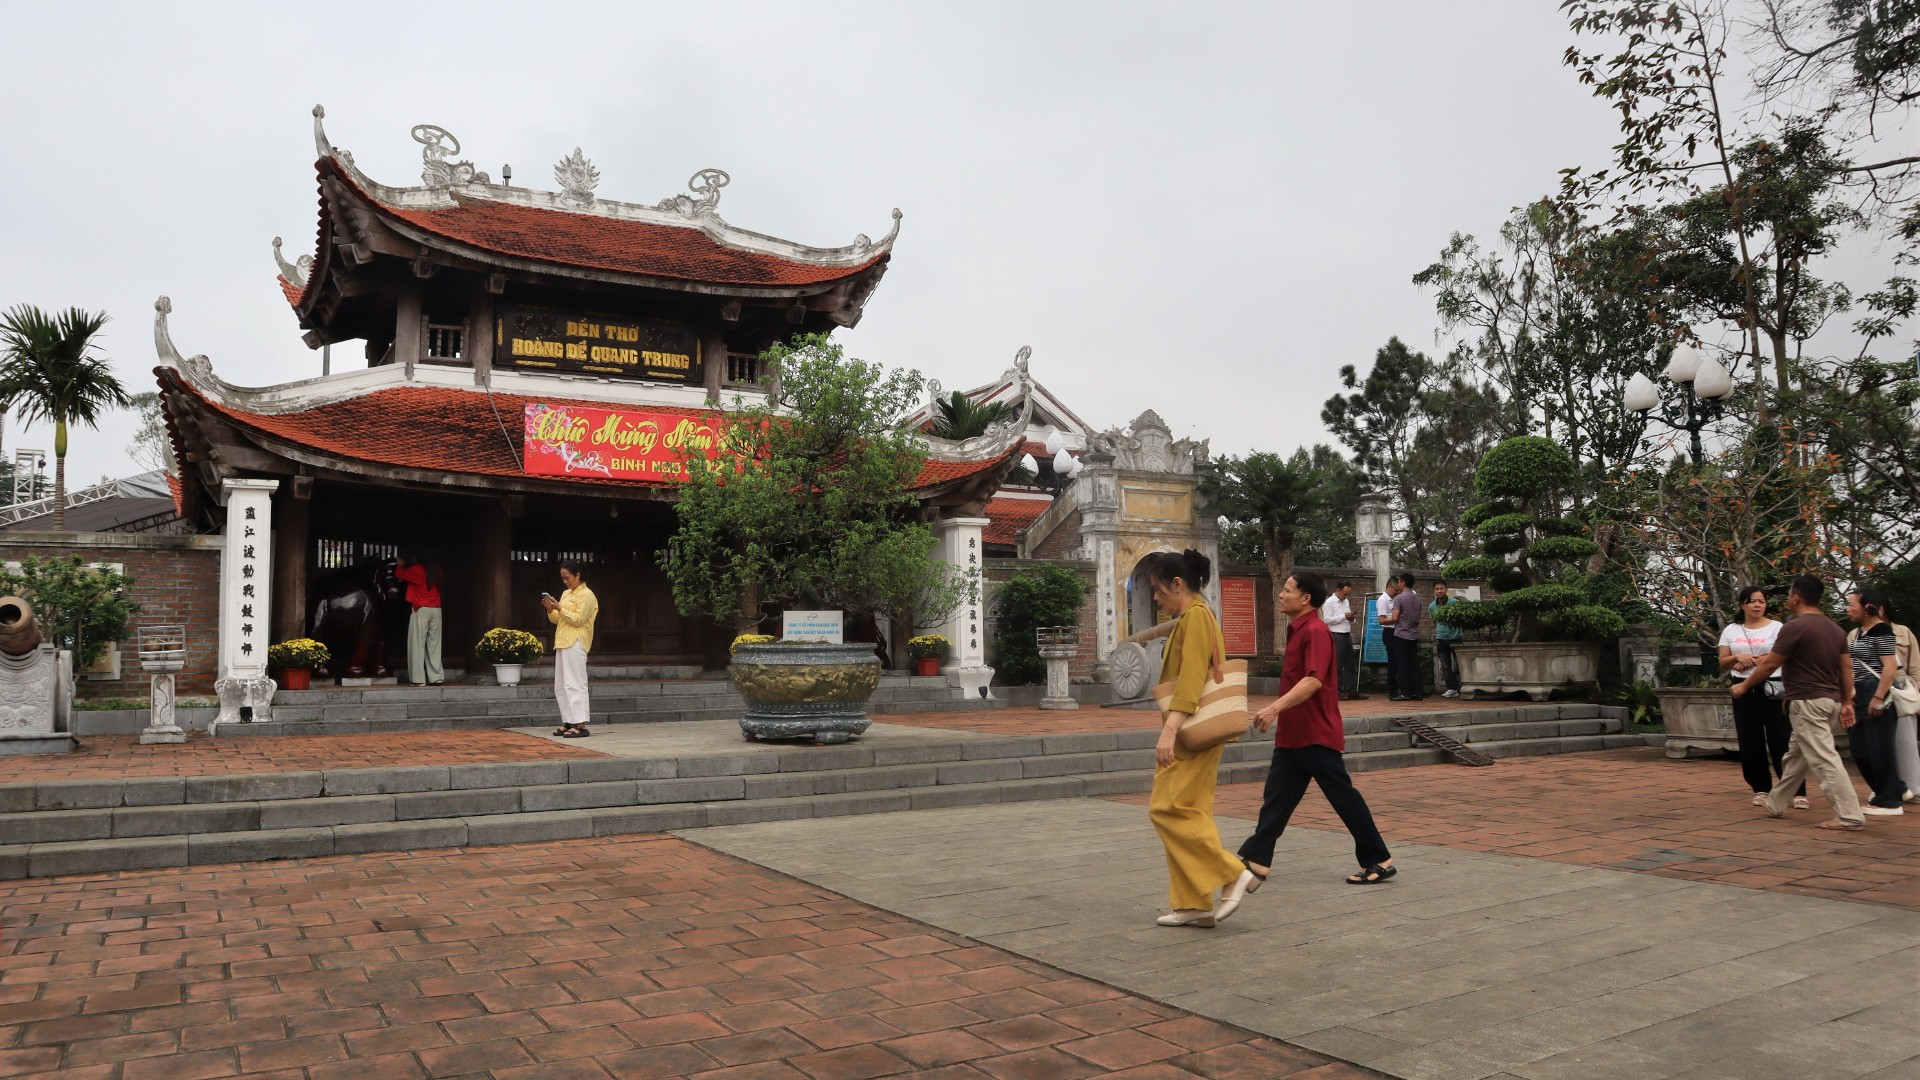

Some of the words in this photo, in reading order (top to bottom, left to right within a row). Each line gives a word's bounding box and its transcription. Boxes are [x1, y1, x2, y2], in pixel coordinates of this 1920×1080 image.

[605, 324, 640, 342] THỜ
[512, 336, 564, 359] HOÀNG
[566, 340, 588, 361] ĐẾ
[591, 346, 638, 366] QUANG
[642, 351, 691, 370] TRUNG
[532, 409, 590, 447] Chúc
[591, 413, 659, 456] Mừng
[611, 456, 647, 472] BÍNH
